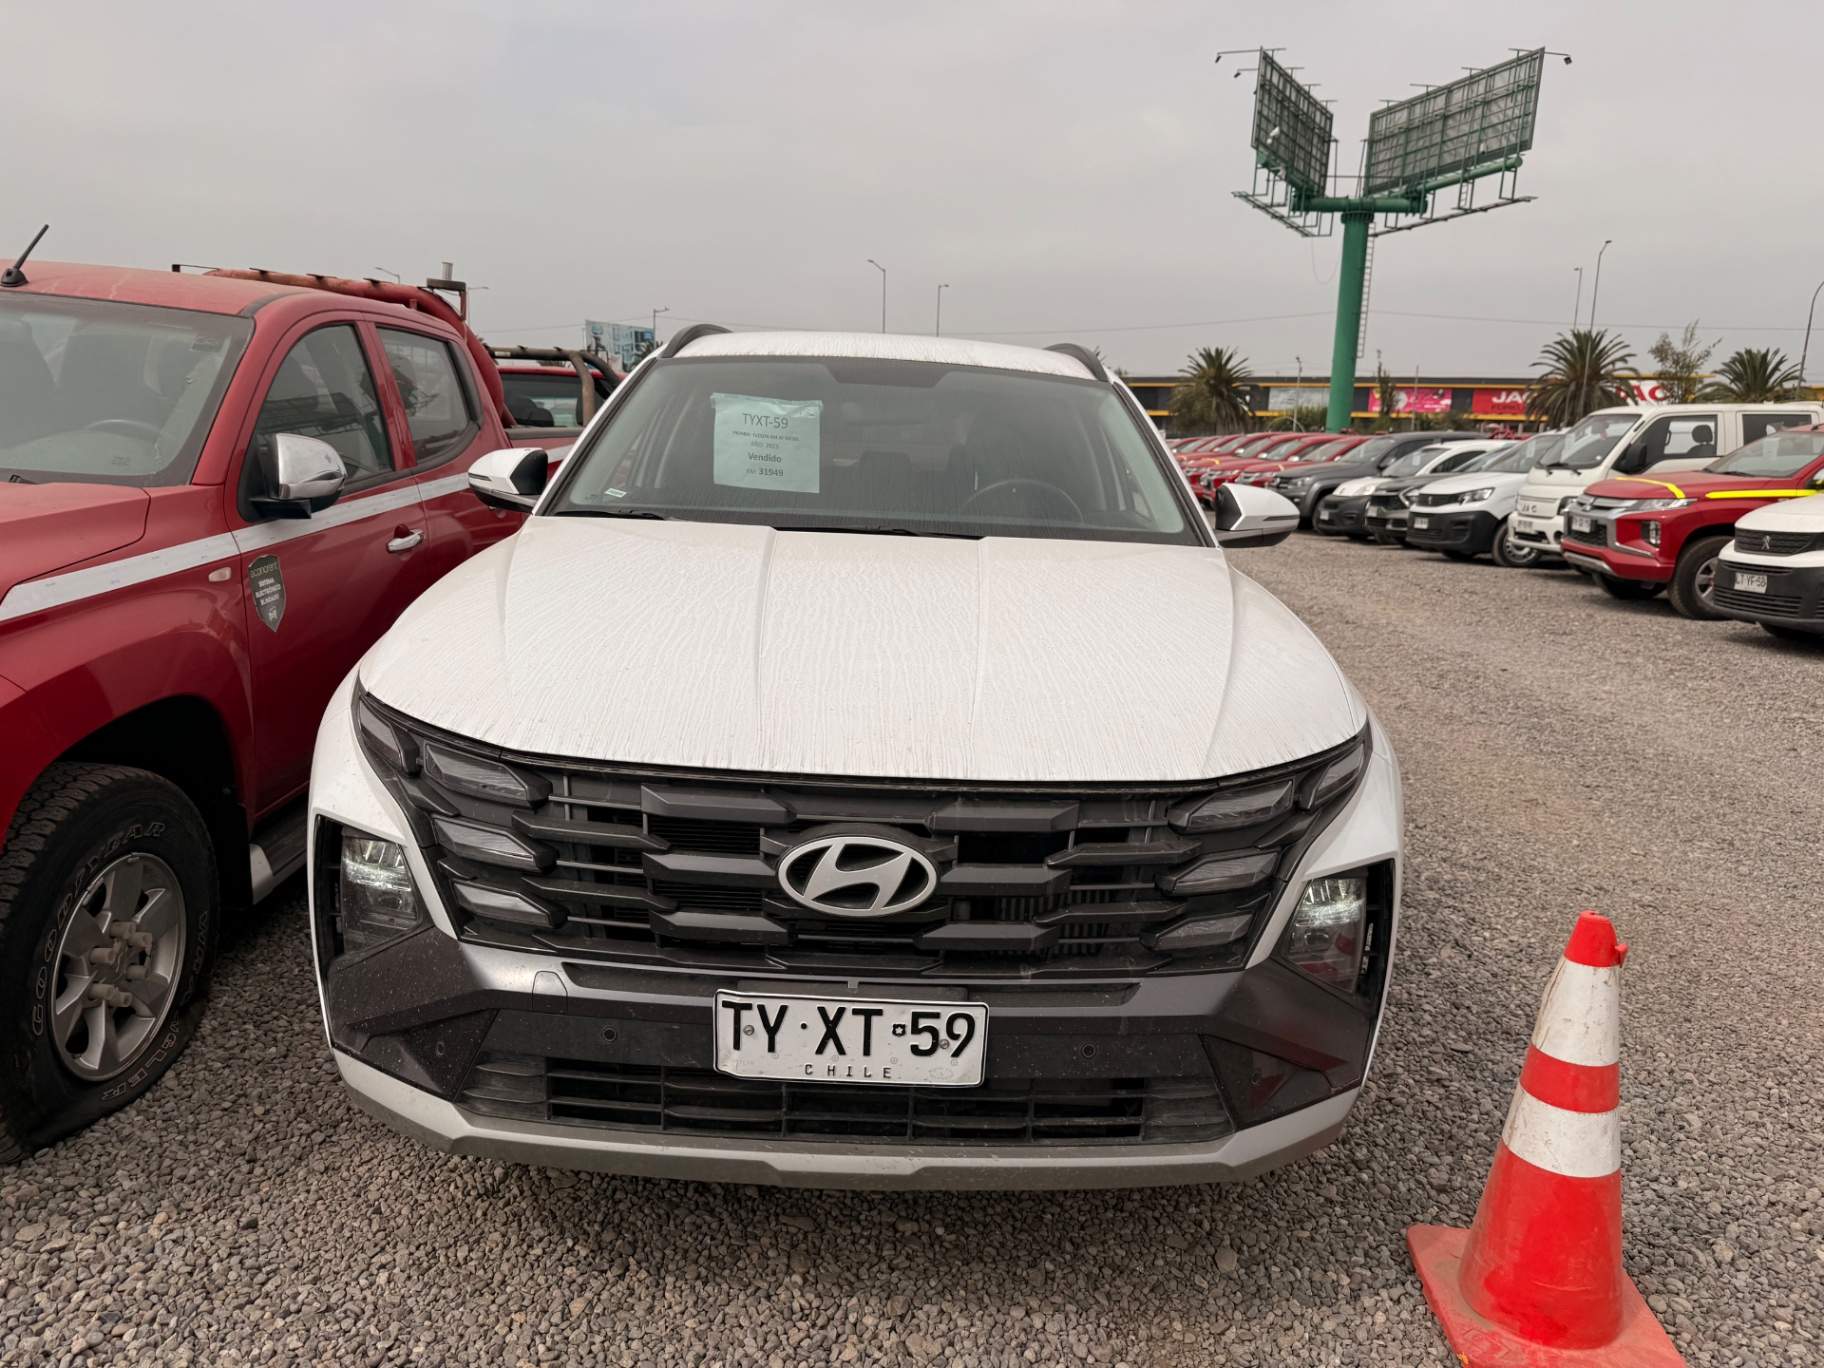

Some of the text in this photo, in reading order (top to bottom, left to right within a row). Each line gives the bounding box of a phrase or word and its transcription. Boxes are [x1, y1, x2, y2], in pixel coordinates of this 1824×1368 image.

[743, 413, 789, 429] TYXT-59
[747, 451, 782, 463] Vendido
[803, 1063, 893, 1079] CHILE
